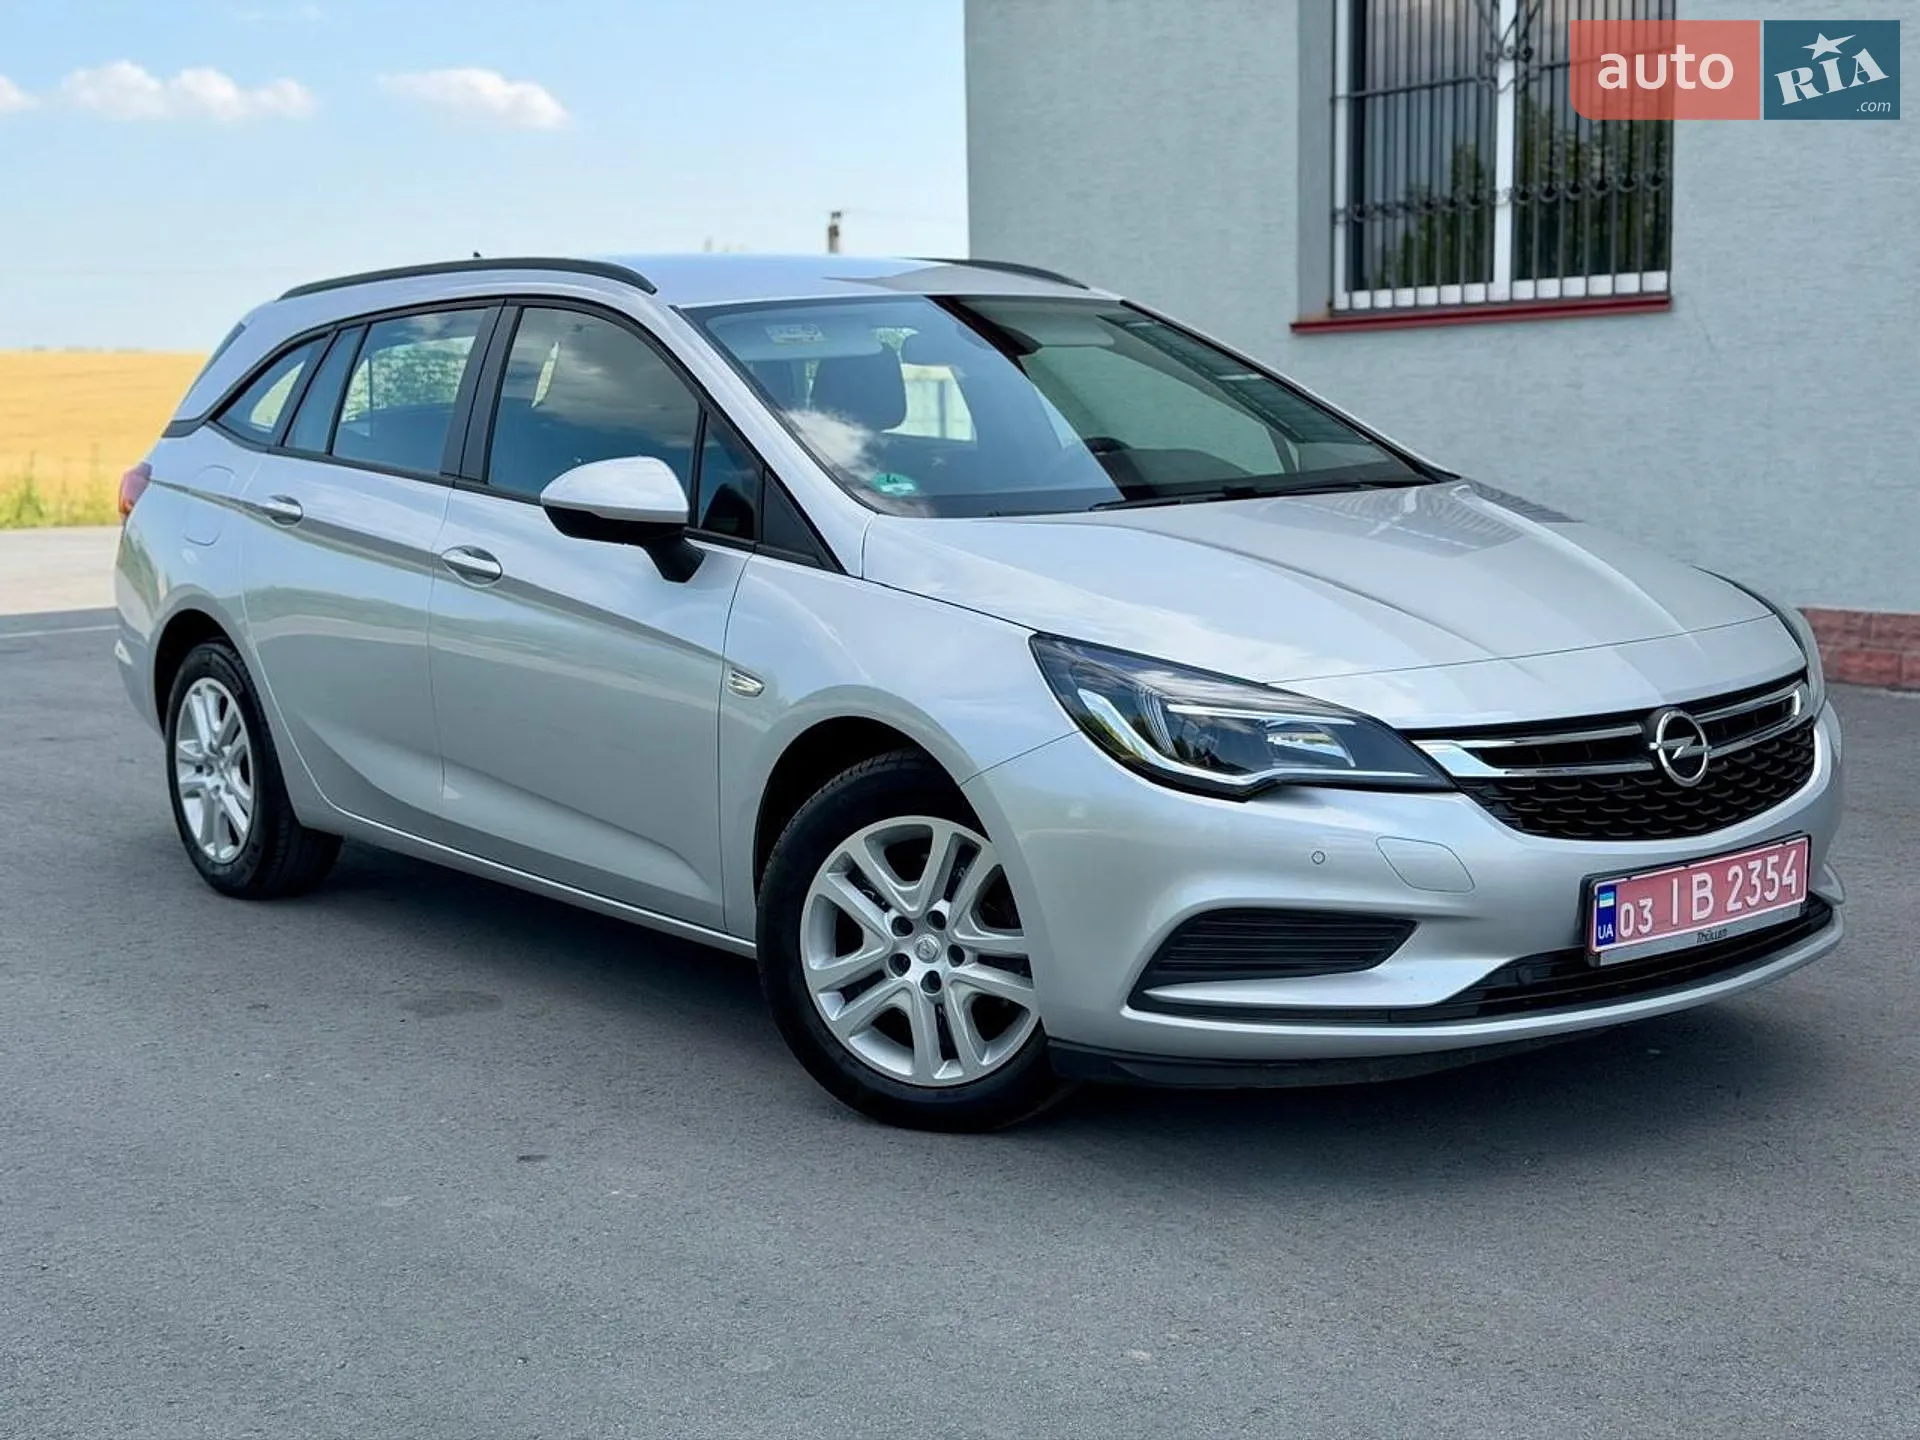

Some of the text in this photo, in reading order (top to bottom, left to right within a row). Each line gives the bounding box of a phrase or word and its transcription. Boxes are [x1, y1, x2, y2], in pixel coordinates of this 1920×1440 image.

[1619, 899, 1652, 937] 03
[1726, 850, 1797, 912] 2354
[1597, 923, 1614, 939] UA
